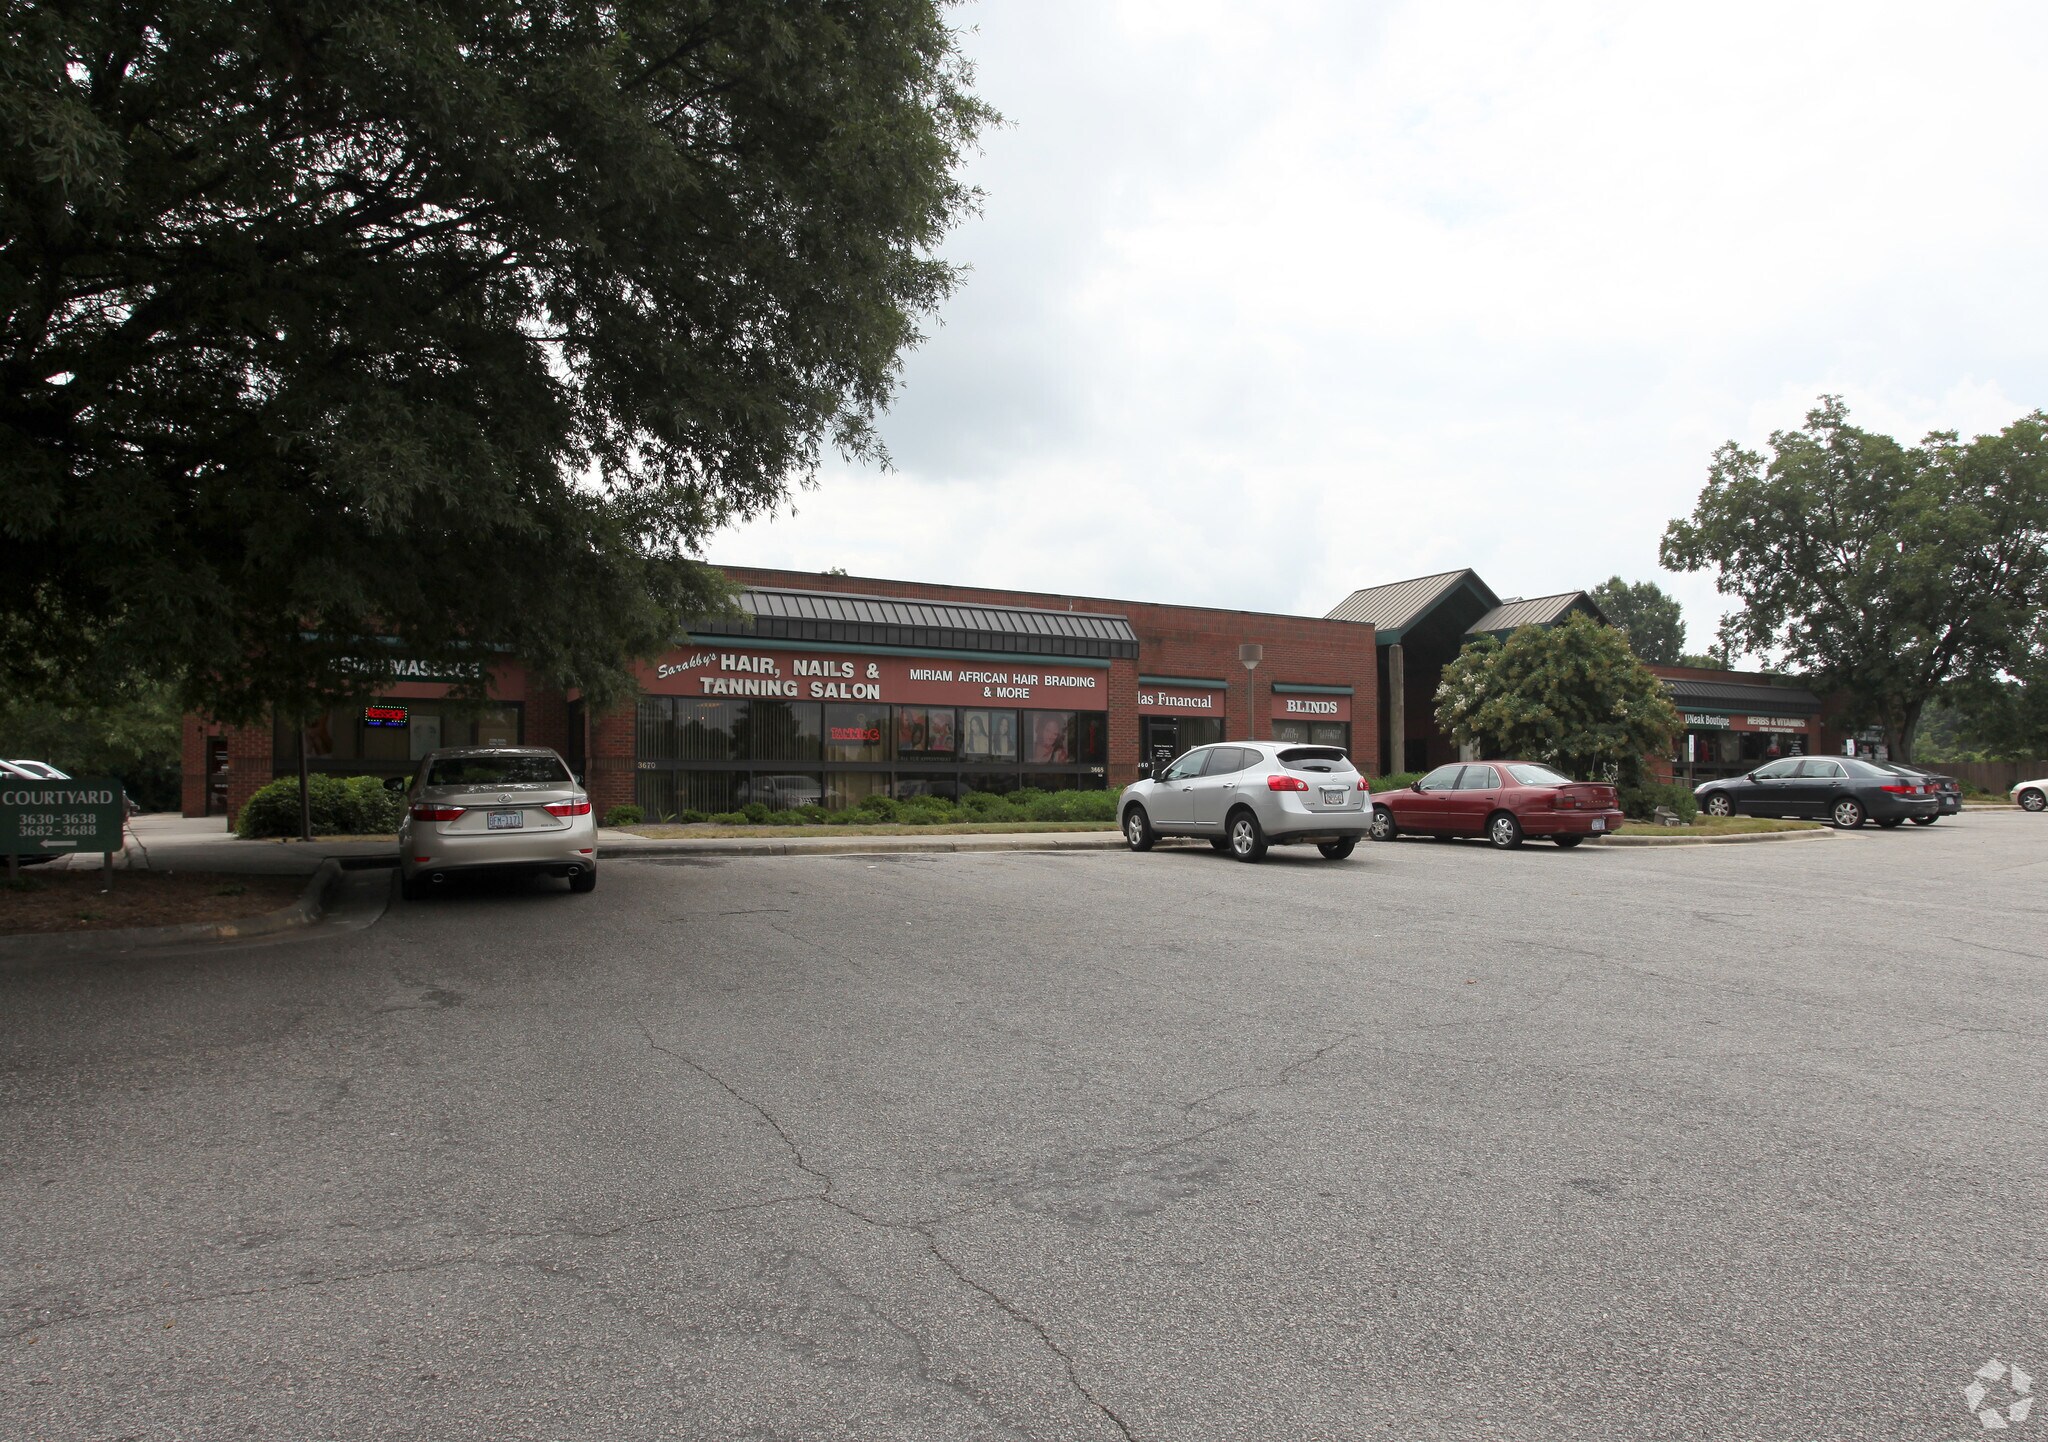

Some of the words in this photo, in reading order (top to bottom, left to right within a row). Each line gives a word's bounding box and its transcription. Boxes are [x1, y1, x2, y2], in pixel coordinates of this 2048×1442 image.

[721, 654, 780, 678] HAIR,
[793, 660, 855, 678] NAILS
[866, 663, 880, 679] &
[910, 669, 953, 682] MIRIAM
[958, 672, 1008, 684] AFRICAN
[1012, 674, 1039, 685] HAIR
[1044, 676, 1096, 688] BRAIDING
[700, 677, 798, 697] TANNING
[810, 683, 880, 700] SALON
[983, 687, 992, 697] &
[997, 688, 1030, 698] MORE
[1157, 691, 1212, 708] Financial
[1286, 700, 1338, 714] BLINDS
[1705, 715, 1730, 729] Boutique
[1747, 716, 1770, 726] HERBS
[831, 727, 880, 740] TANNING
[637, 761, 656, 769] 3670
[2, 790, 113, 806] COURTYARD
[18, 813, 97, 825] 3630-3638
[18, 825, 97, 837] 3682-3688
